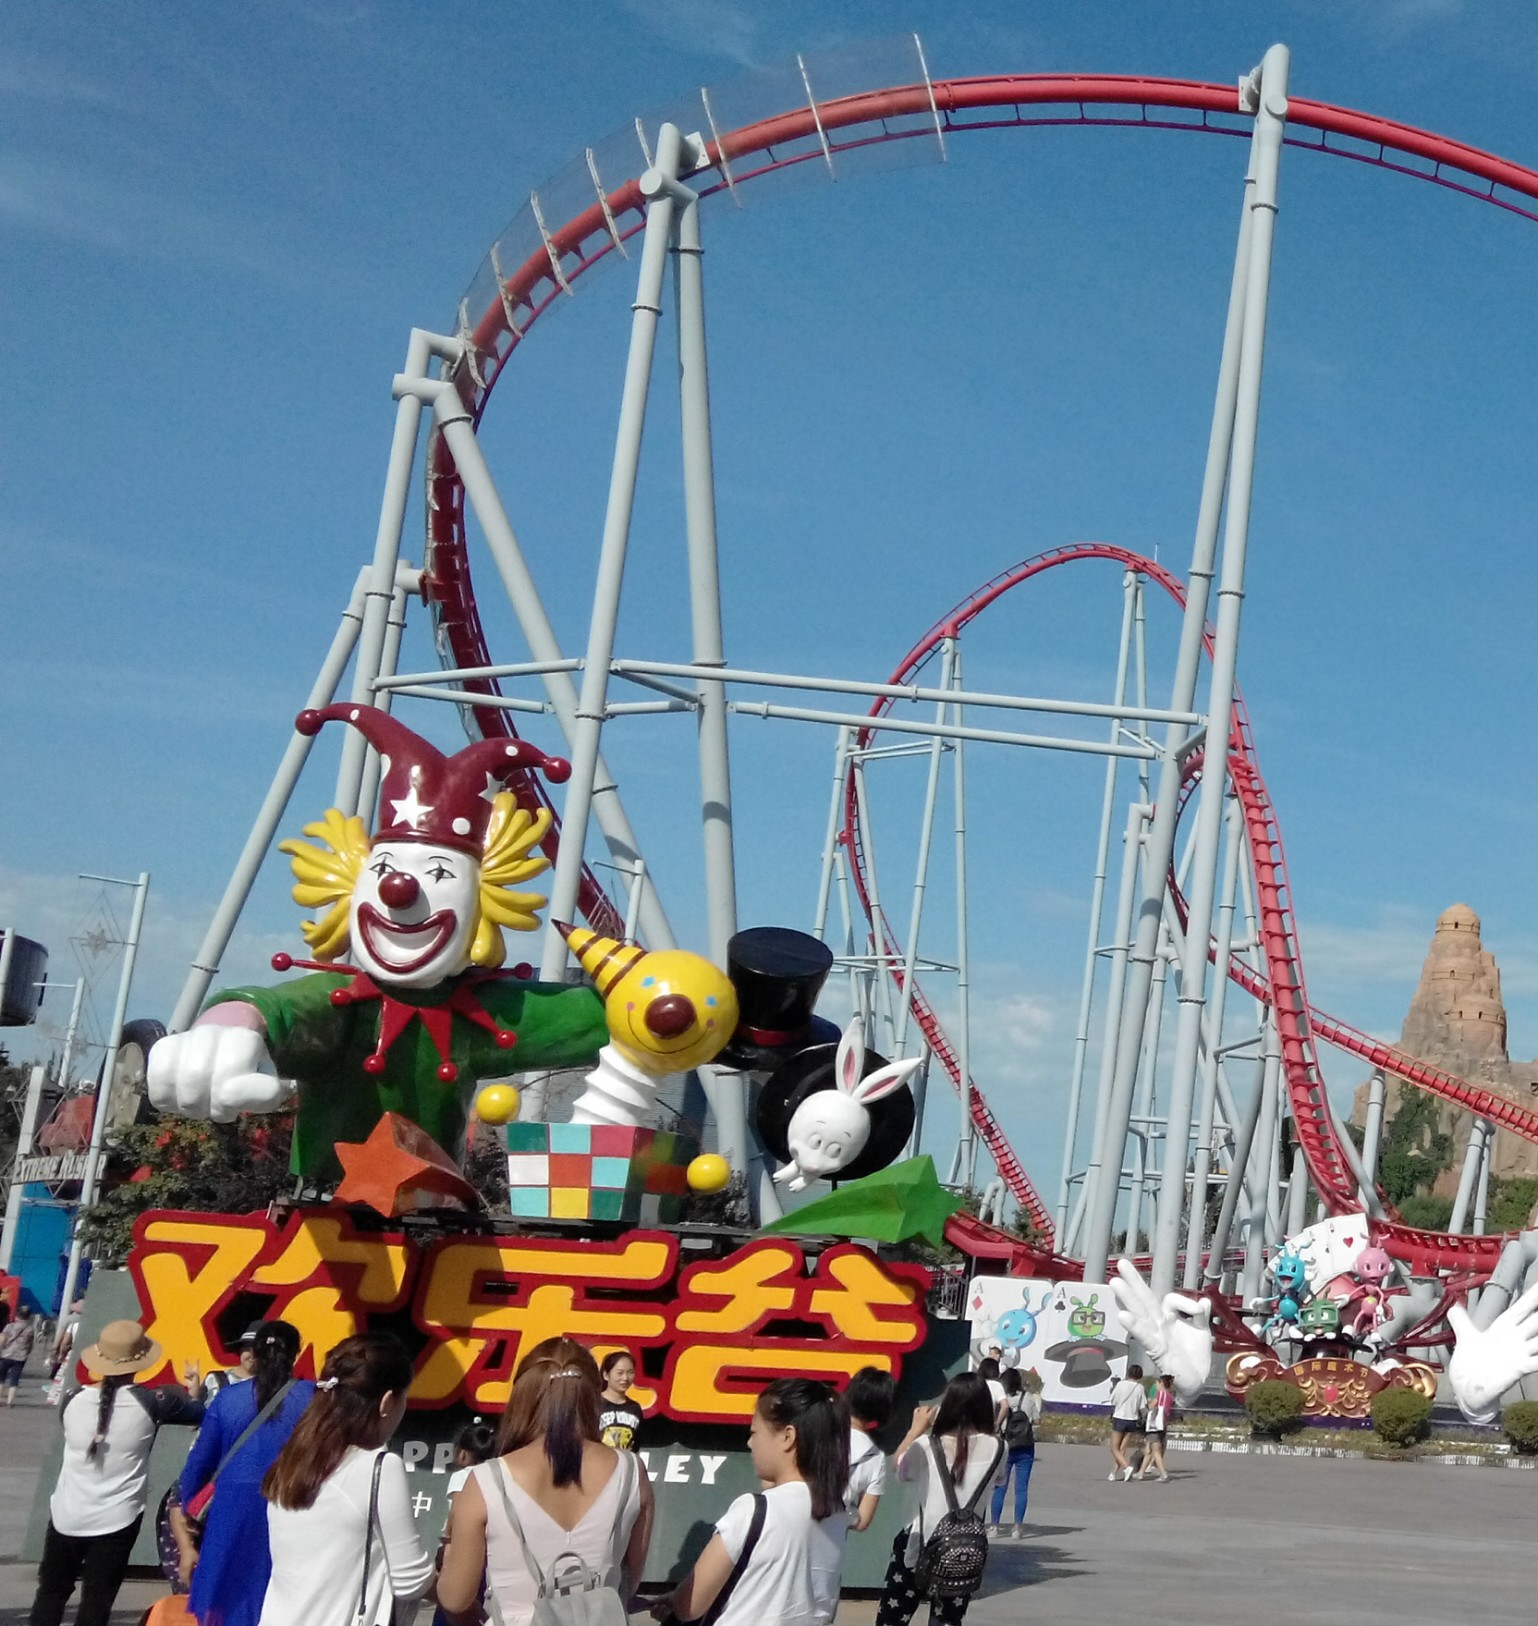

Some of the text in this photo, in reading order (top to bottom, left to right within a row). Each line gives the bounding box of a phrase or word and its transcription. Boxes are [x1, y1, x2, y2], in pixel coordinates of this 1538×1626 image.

[59, 1150, 107, 1180] RUSHR
[974, 1282, 984, 1294] A
[1056, 1287, 1067, 1299] A
[82, 1212, 924, 1420] 欢乐谷
[639, 1451, 728, 1485] LEY
